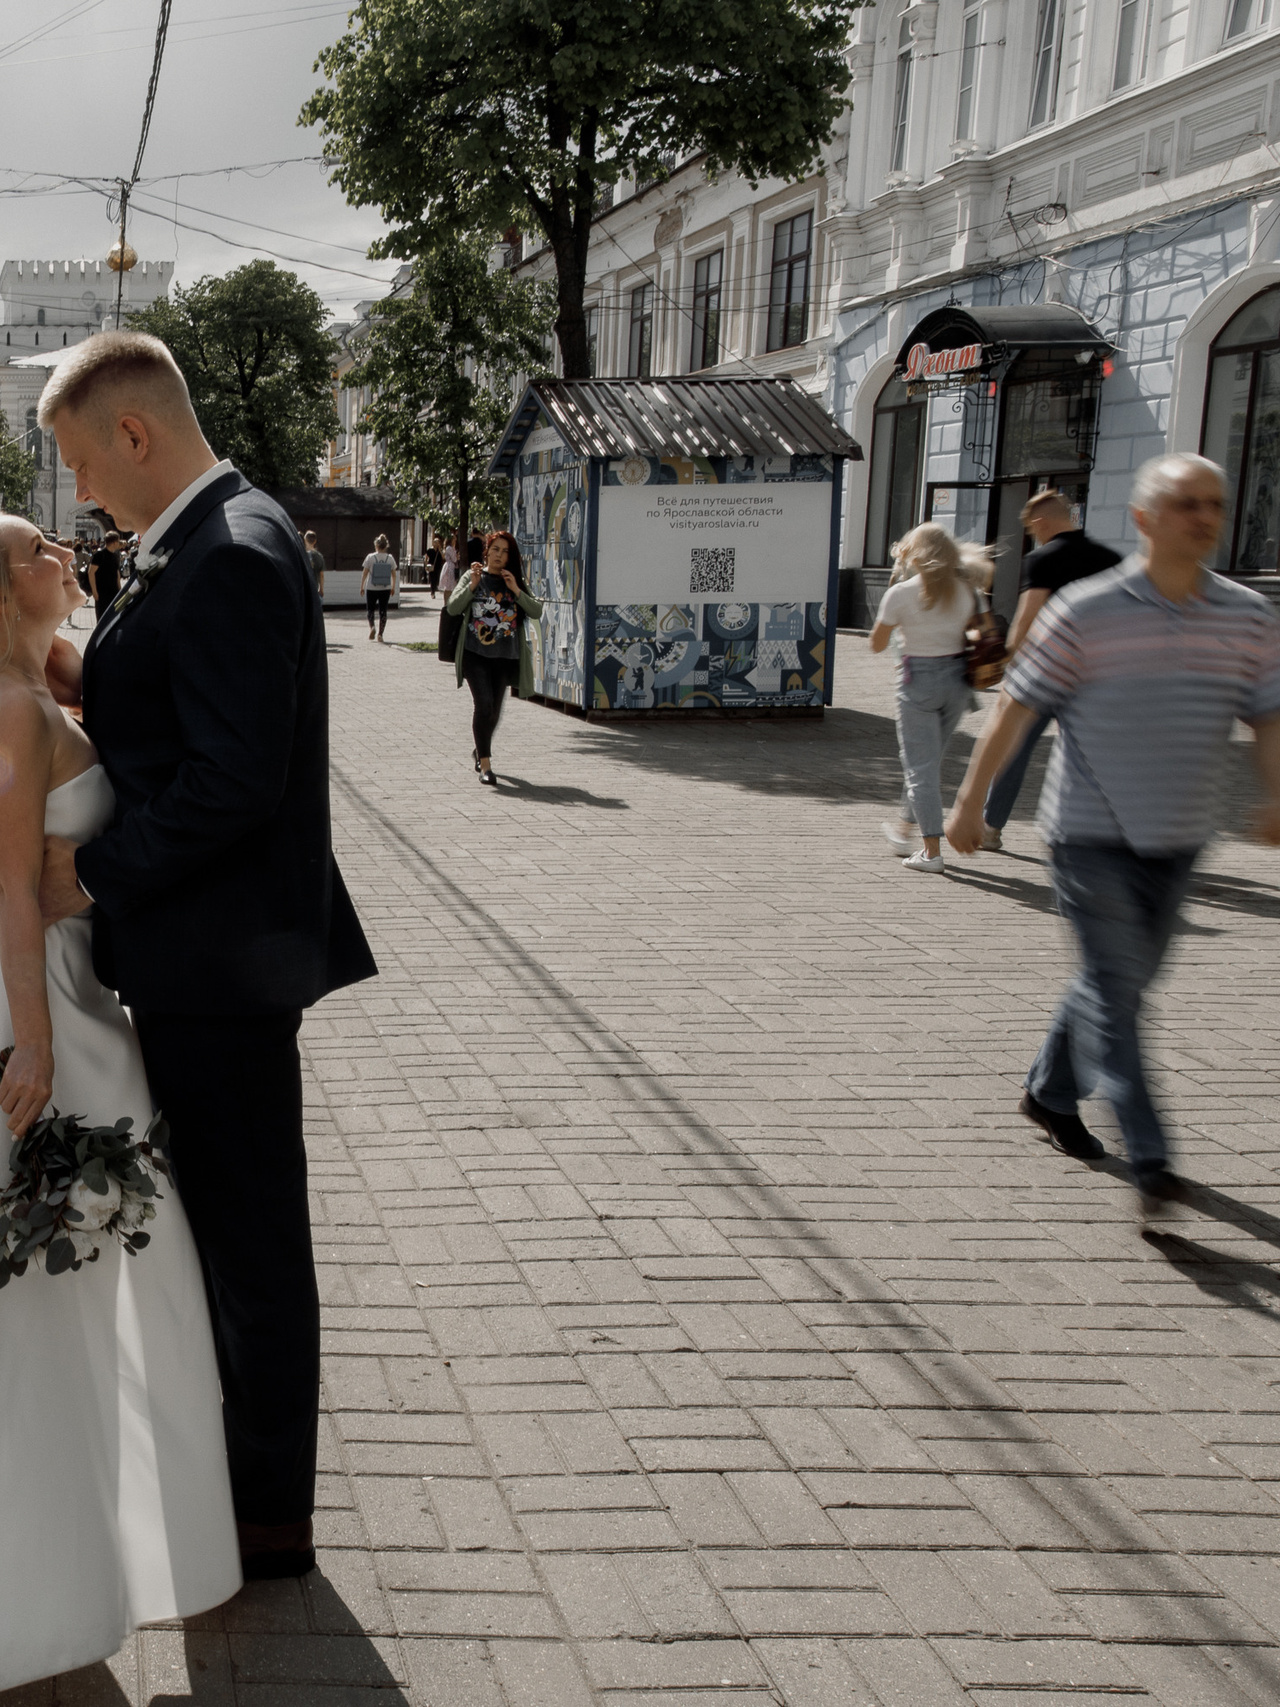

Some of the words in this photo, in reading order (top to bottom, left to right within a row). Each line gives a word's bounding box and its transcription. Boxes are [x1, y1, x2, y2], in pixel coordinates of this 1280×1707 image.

[902, 342, 982, 382] Яхонт
[657, 496, 677, 507] Всё
[679, 497, 700, 508] для
[703, 496, 774, 508] путешествия
[646, 510, 661, 519] по
[663, 507, 735, 519] Ярославской
[737, 507, 783, 517] области
[669, 518, 760, 531] visityaroslavia.ru
